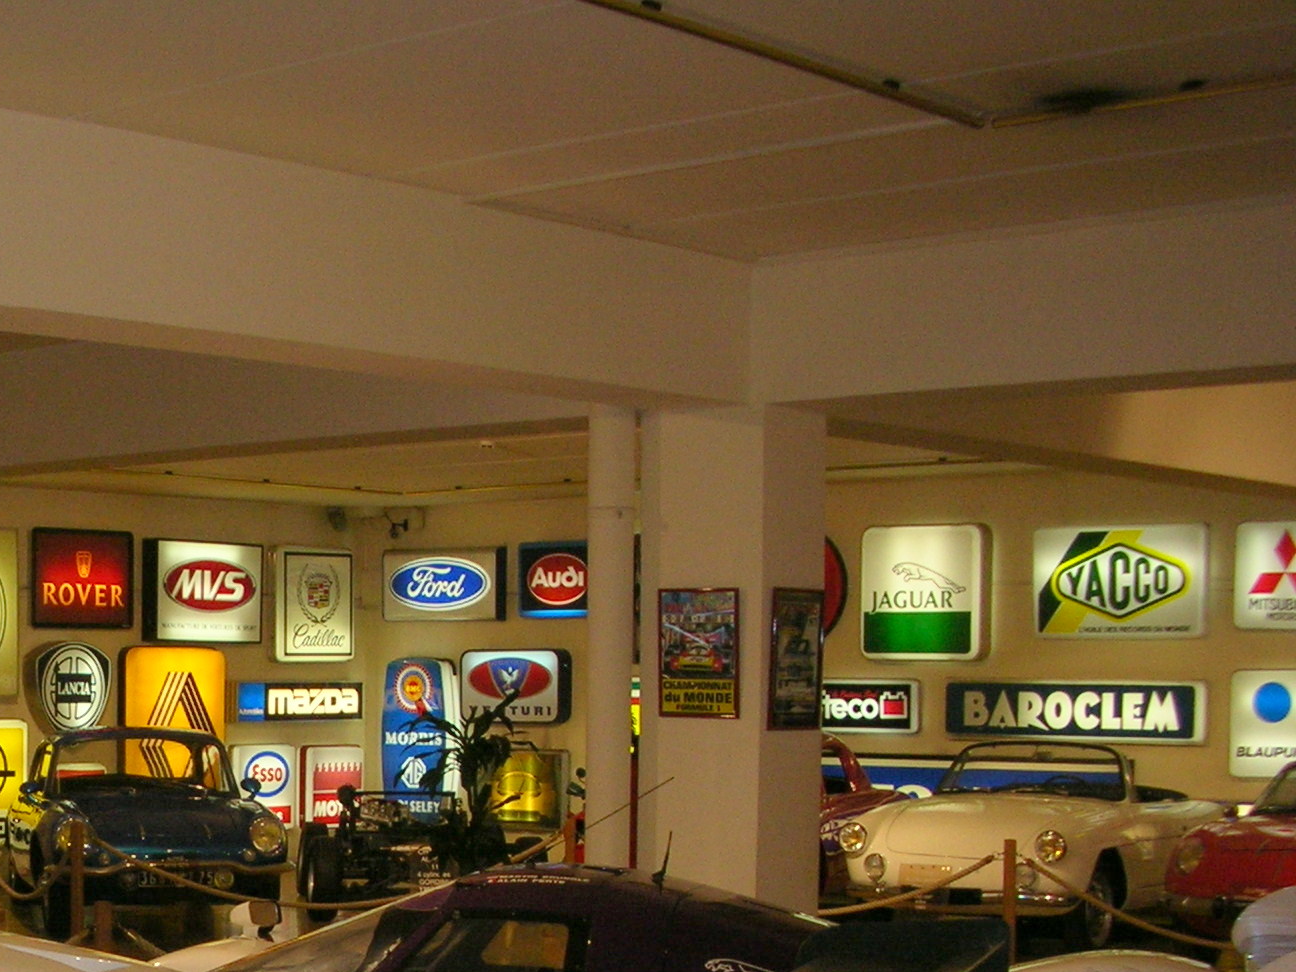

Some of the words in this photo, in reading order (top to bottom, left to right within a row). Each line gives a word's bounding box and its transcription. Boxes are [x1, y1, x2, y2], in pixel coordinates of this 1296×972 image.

[173, 568, 248, 601] MVS
[407, 566, 467, 598] Ford
[1066, 551, 1169, 610] YACCO
[43, 582, 125, 607] ROVER
[871, 590, 953, 613] JAGUAR
[292, 624, 347, 649] Cadillac
[57, 681, 91, 696] LANCIA
[664, 691, 681, 704] du
[683, 691, 733, 704] MONDE
[469, 705, 552, 717] VETURI
[821, 690, 879, 720] teco
[963, 689, 1181, 733] BAROCLEM
[385, 731, 442, 747] MORRIS
